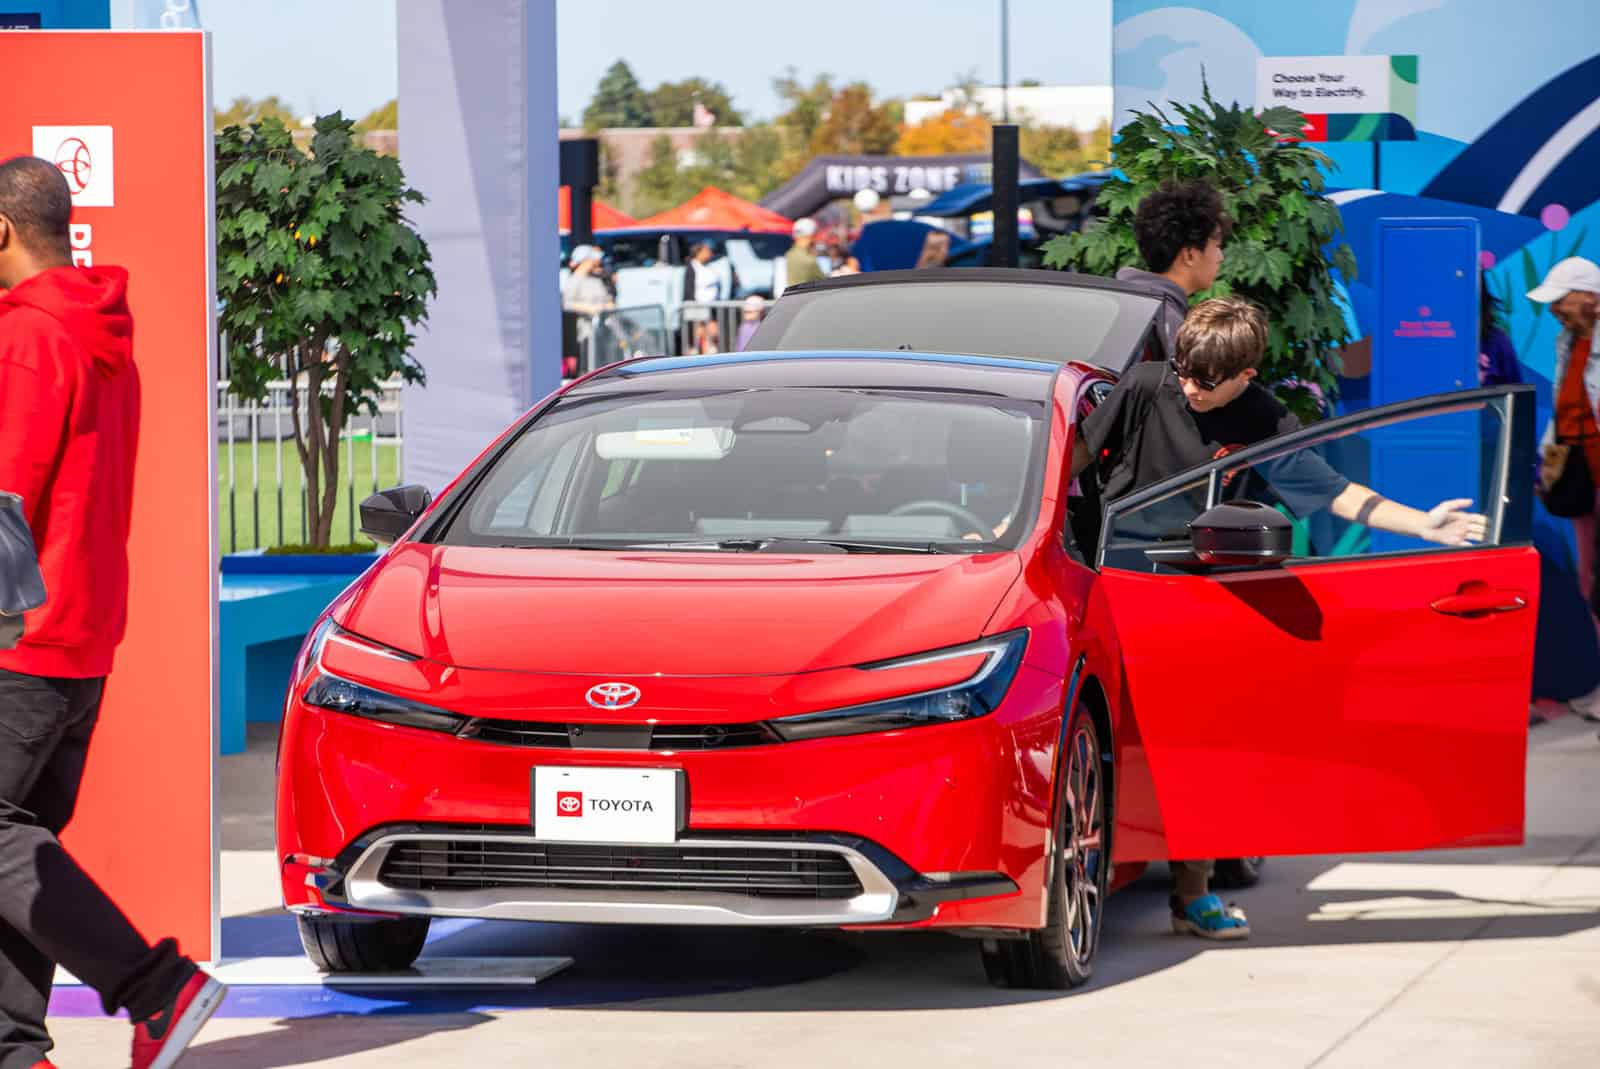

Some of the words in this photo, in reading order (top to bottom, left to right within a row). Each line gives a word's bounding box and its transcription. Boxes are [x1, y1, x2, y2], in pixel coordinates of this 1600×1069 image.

[1272, 73, 1316, 83] Choose
[1319, 73, 1344, 82] Your
[1272, 88, 1297, 99] Way
[1300, 89, 1312, 97] to
[1316, 87, 1366, 99] Electrify.
[827, 166, 888, 192] KIDS
[894, 166, 961, 192] ZONE
[589, 798, 653, 812] TOYOTA
